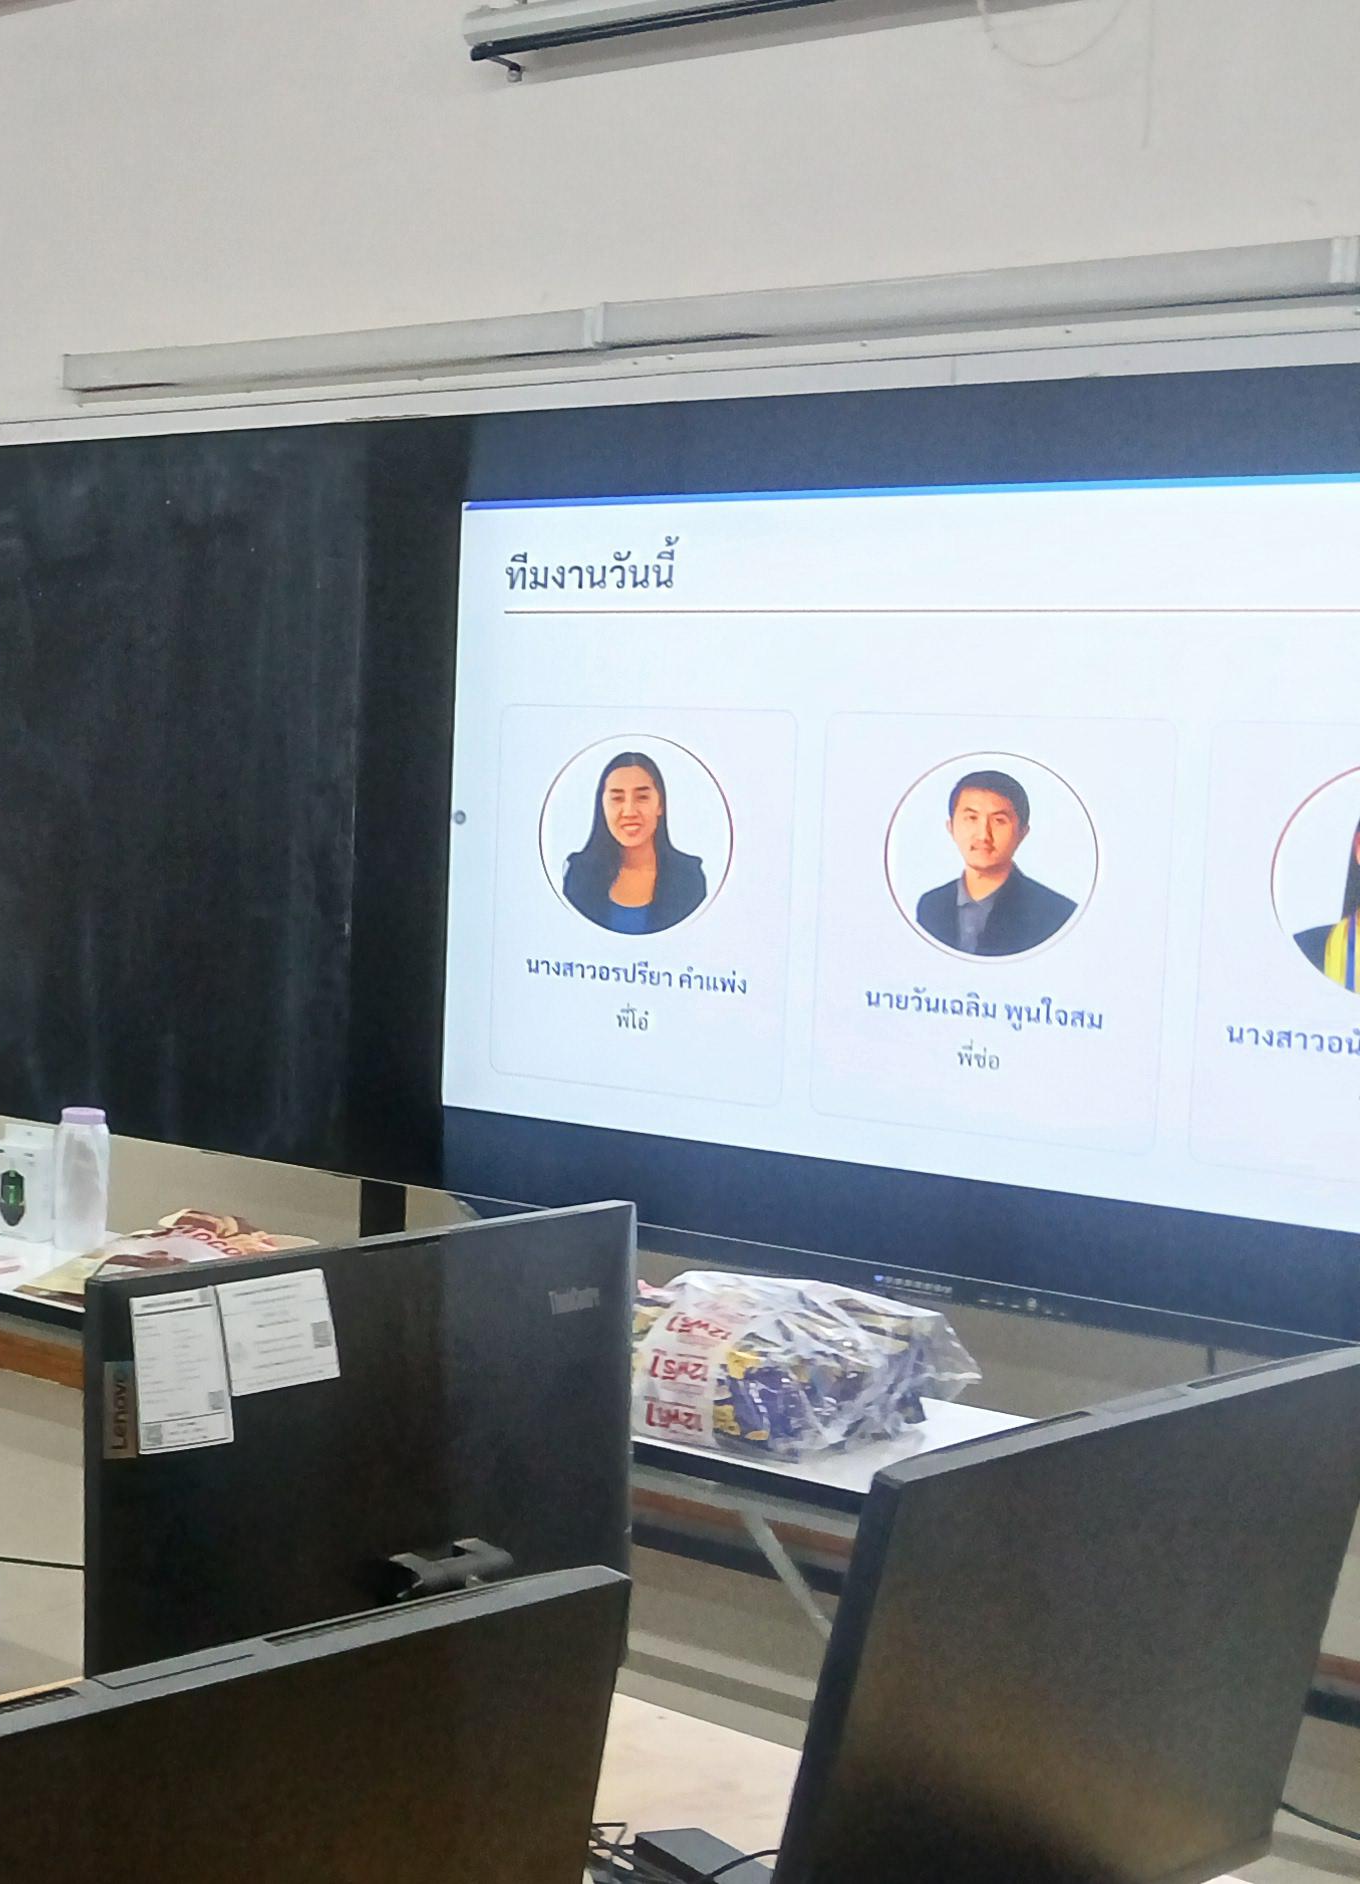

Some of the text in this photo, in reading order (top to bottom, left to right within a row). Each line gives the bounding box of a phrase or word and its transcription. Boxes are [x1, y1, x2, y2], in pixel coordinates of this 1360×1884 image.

[505, 536, 680, 590] ทีมงานวันนี้
[526, 958, 673, 987] นางสาวอรปรียา
[865, 986, 1103, 1031] นายวันเฉลิม พูนใจสม
